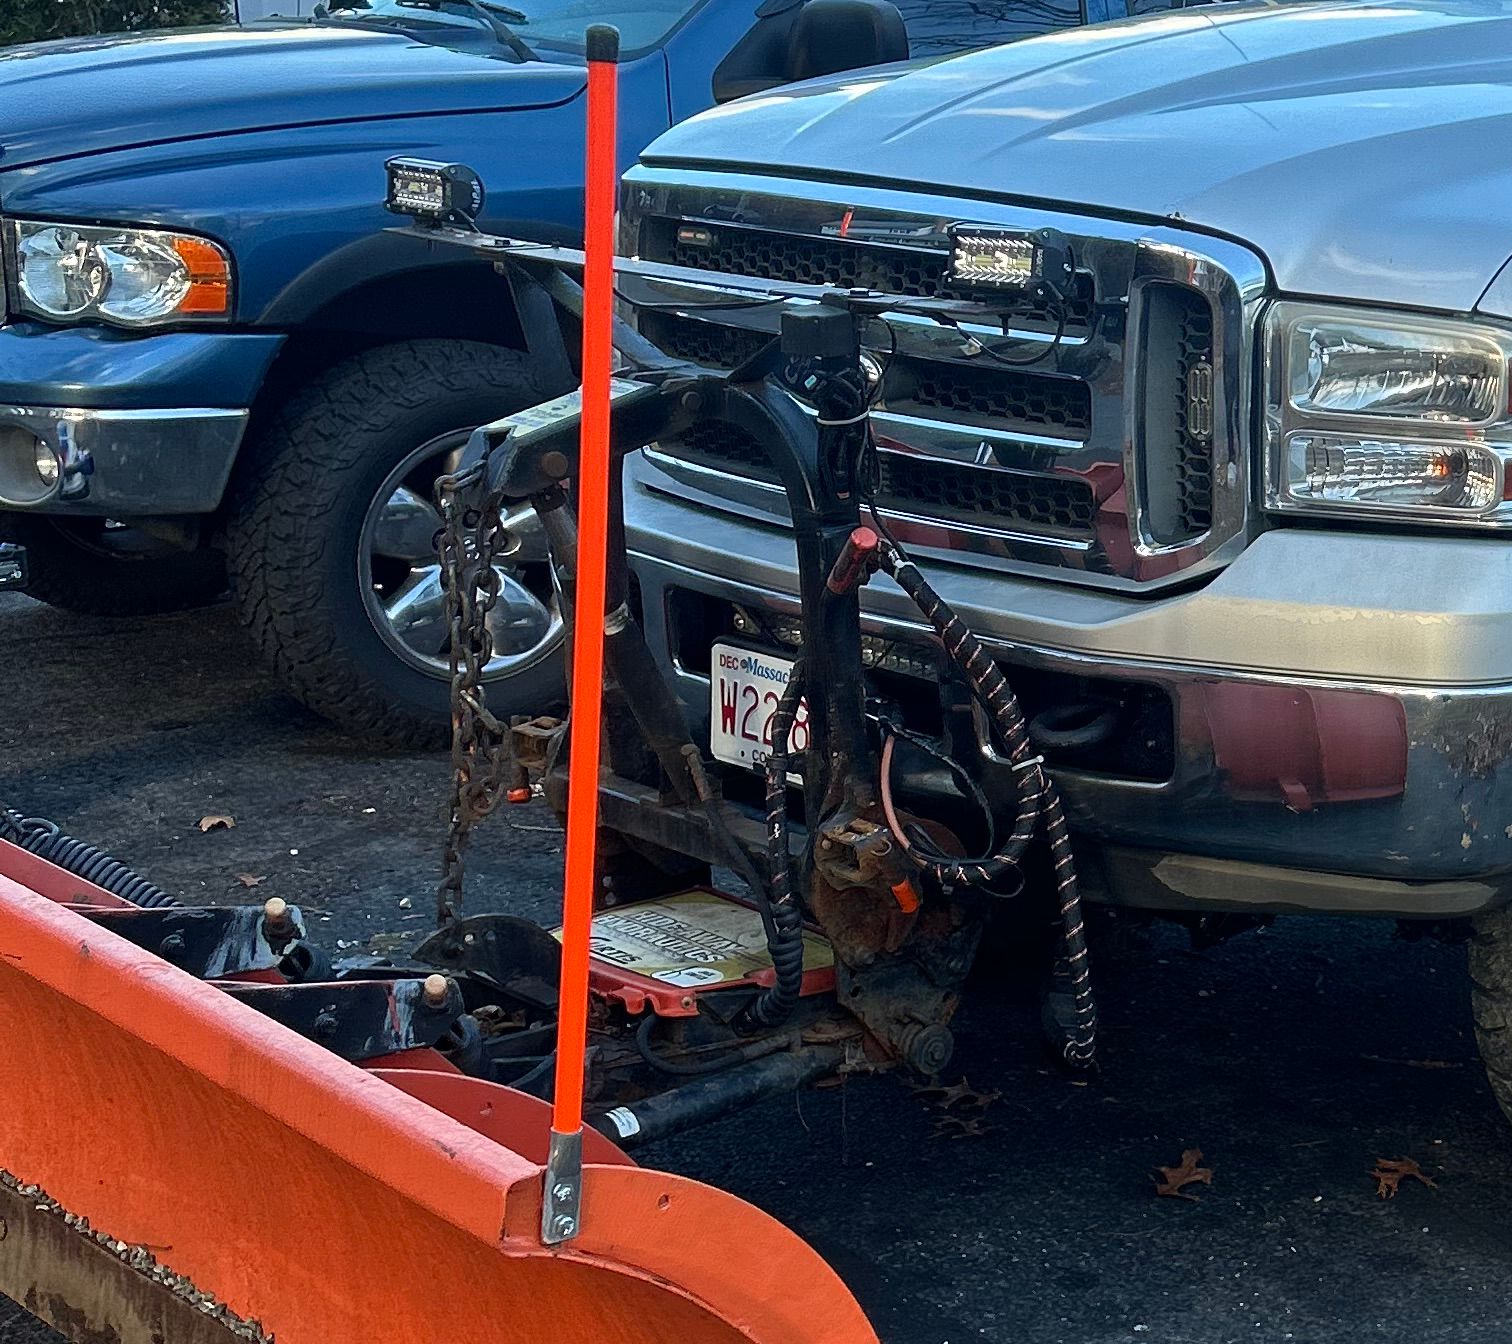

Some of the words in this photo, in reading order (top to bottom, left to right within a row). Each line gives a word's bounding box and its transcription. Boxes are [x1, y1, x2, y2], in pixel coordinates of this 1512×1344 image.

[719, 653, 739, 670] DEC
[746, 657, 792, 684] Massac
[592, 914, 727, 963] HYDRAULICS
